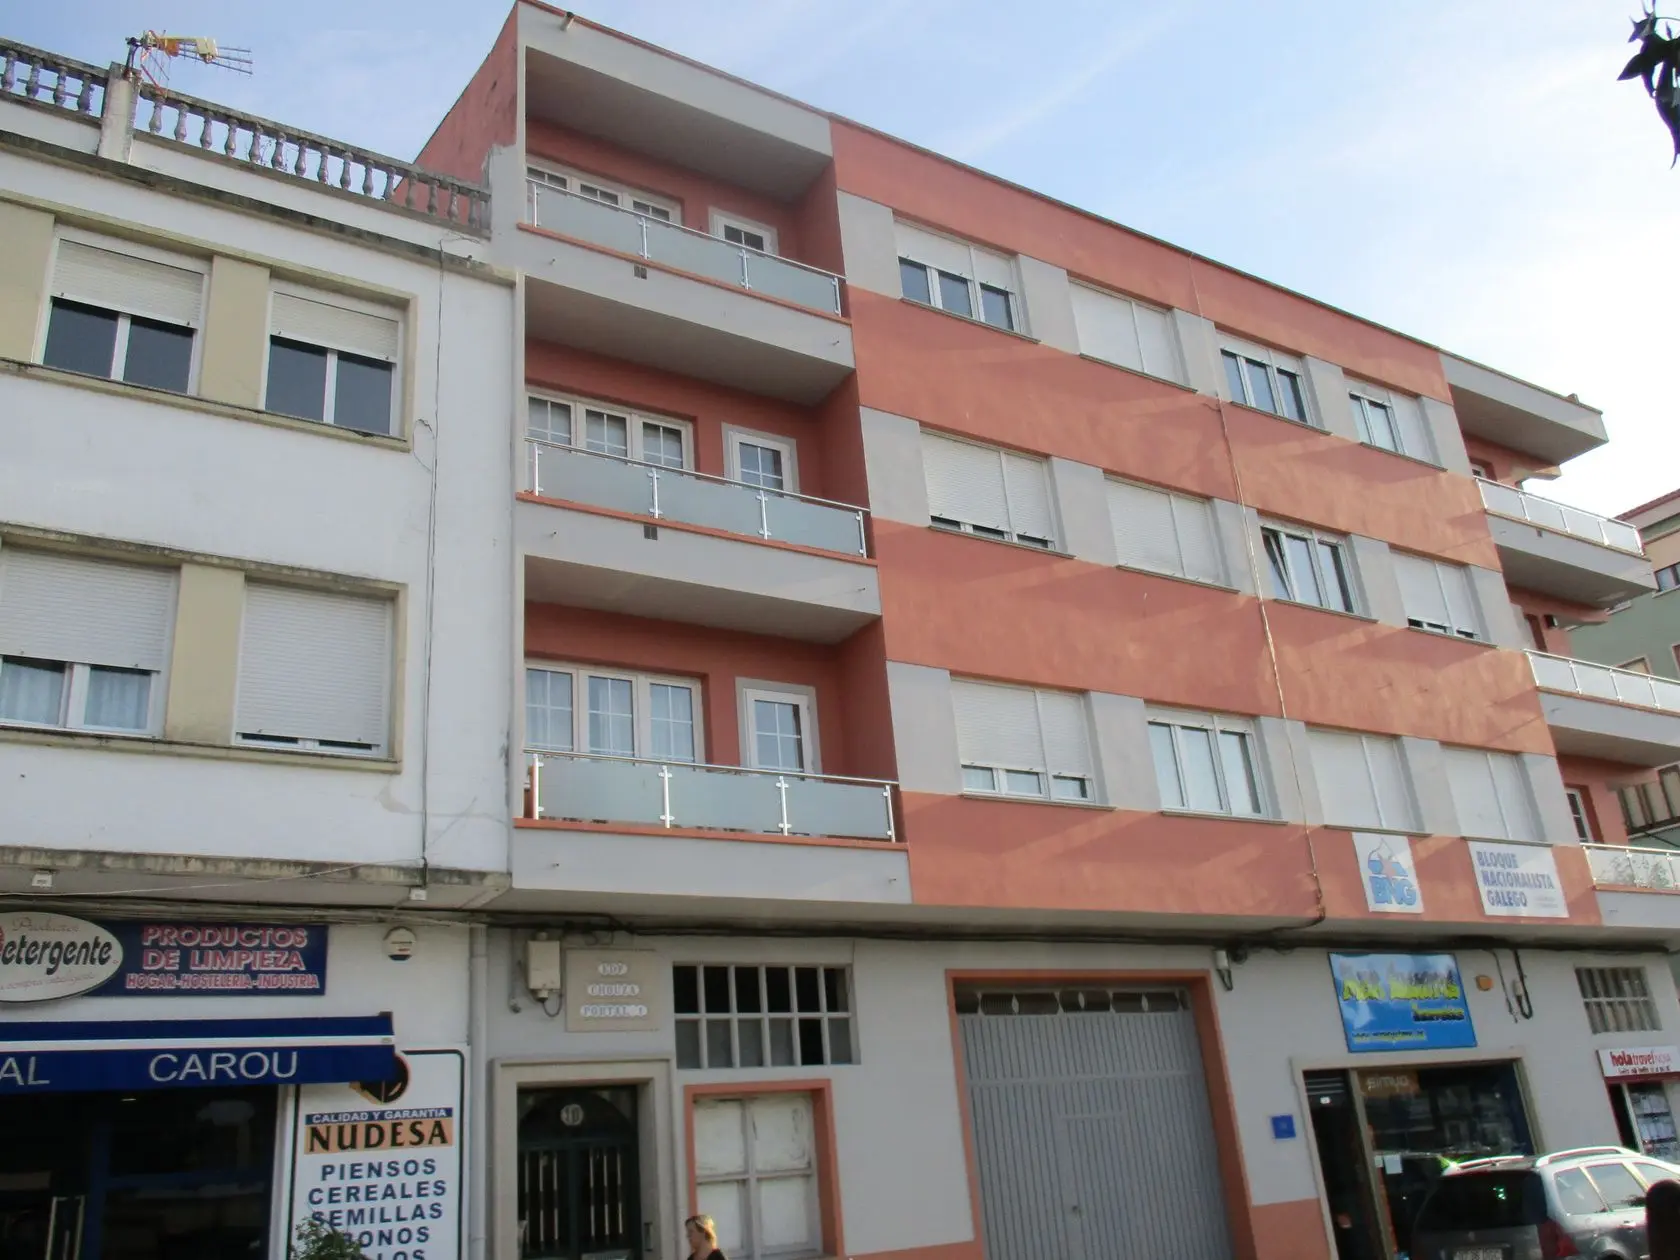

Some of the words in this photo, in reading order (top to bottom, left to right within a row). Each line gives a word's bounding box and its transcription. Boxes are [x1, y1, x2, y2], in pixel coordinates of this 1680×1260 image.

[1475, 851, 1518, 869] BLOQUE
[1481, 871, 1555, 889] NACIONALISTA
[1486, 889, 1528, 907] GALEGO
[142, 925, 308, 948] PRODUCTOS
[0, 927, 113, 976] etergente
[143, 949, 180, 971] DE
[189, 949, 306, 971] LIMPIEZA
[149, 1051, 298, 1082] CAROU
[312, 1112, 369, 1124] CALIDAD
[373, 1112, 382, 1121] Y
[384, 1108, 447, 1120] GARANTIA
[309, 1120, 448, 1152] NUDESA
[321, 1158, 436, 1181] PIENSOS
[308, 1179, 447, 1205] CEREALES
[311, 1202, 443, 1228] SEMILLAS
